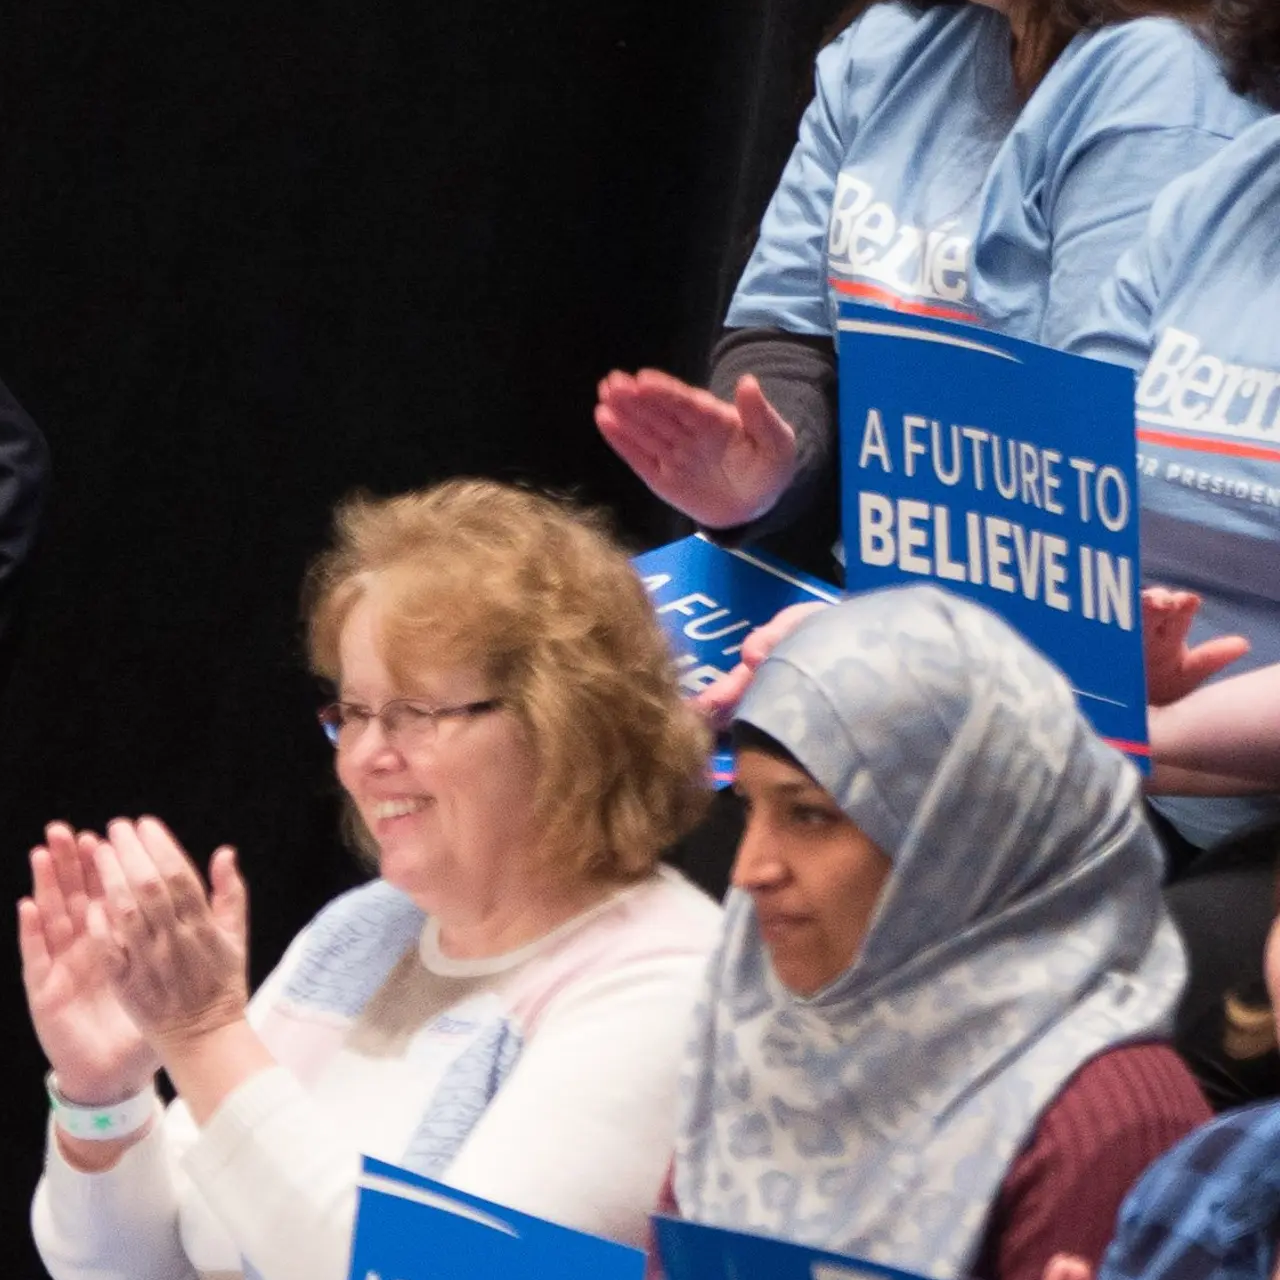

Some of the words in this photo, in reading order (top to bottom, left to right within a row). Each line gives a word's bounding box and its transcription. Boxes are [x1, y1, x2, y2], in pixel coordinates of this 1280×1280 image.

[858, 407, 893, 474] A
[901, 414, 1065, 516] FUTURE
[1068, 456, 1130, 533] TO
[858, 490, 1071, 613] BELIEVE
[1078, 544, 1133, 632] IN
